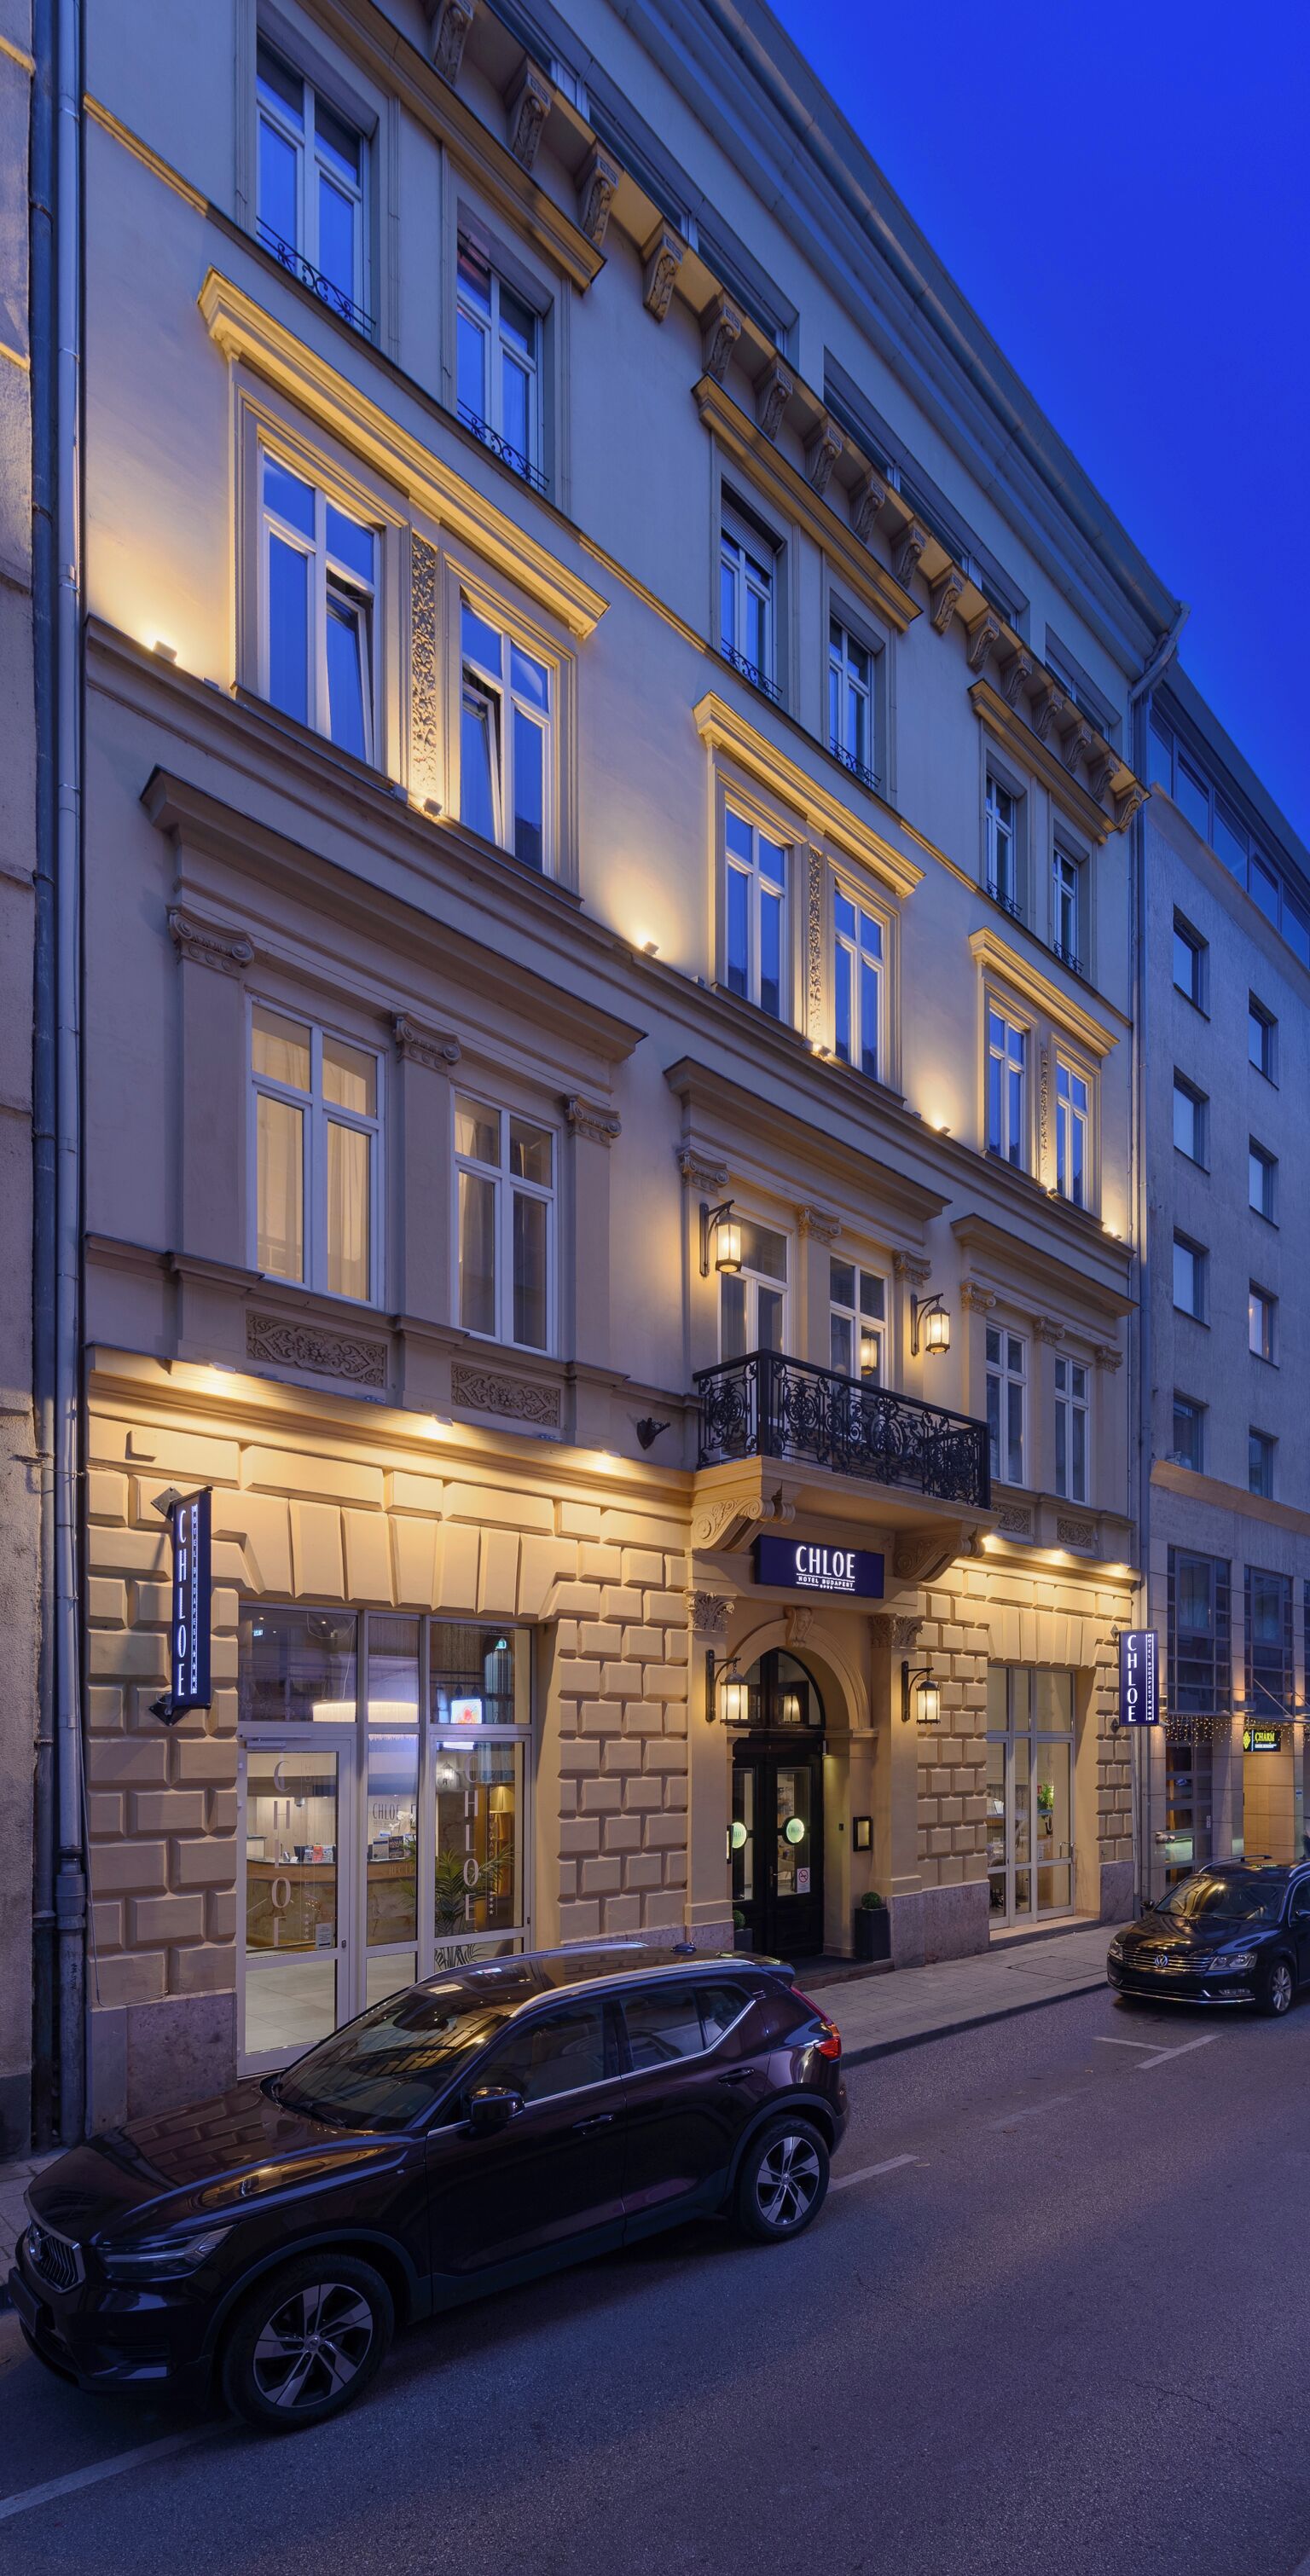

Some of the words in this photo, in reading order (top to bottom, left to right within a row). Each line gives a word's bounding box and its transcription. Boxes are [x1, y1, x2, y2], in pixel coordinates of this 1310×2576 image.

[177, 1509, 187, 1697] CHLOE
[796, 1546, 855, 1578] CHLOE
[821, 1578, 853, 1588] BUDAPEST
[1127, 1635, 1138, 1722] CHLOE
[271, 1760, 291, 1947] CHLOE
[373, 1803, 401, 1821] CHLOE
[463, 1755, 479, 1920] CHLOE
